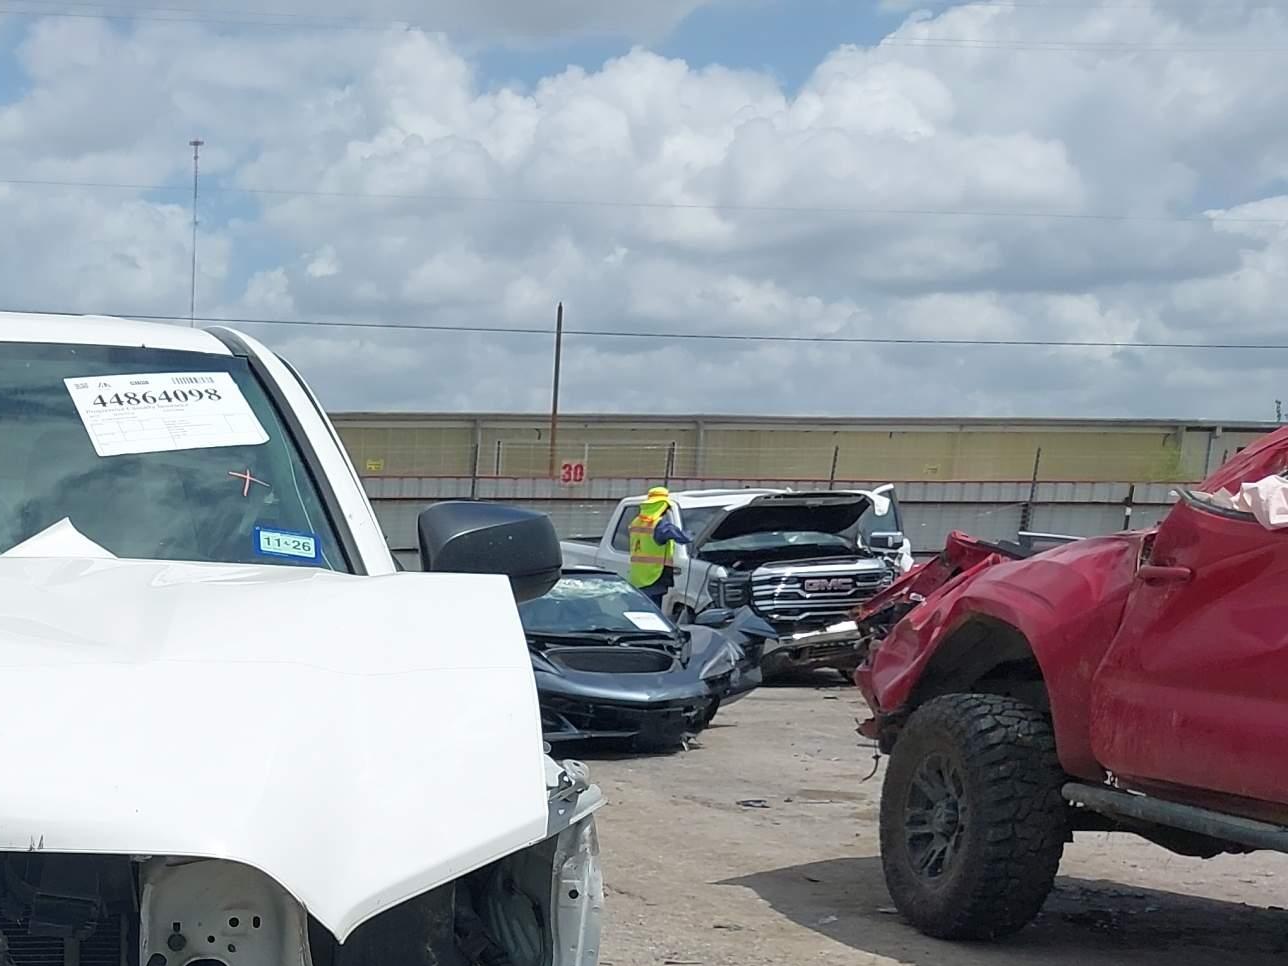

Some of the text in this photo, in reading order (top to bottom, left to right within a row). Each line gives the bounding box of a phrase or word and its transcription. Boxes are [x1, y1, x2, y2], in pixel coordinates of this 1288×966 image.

[93, 388, 223, 407] 44864098
[562, 463, 584, 483] 30
[805, 578, 853, 591] GMC
